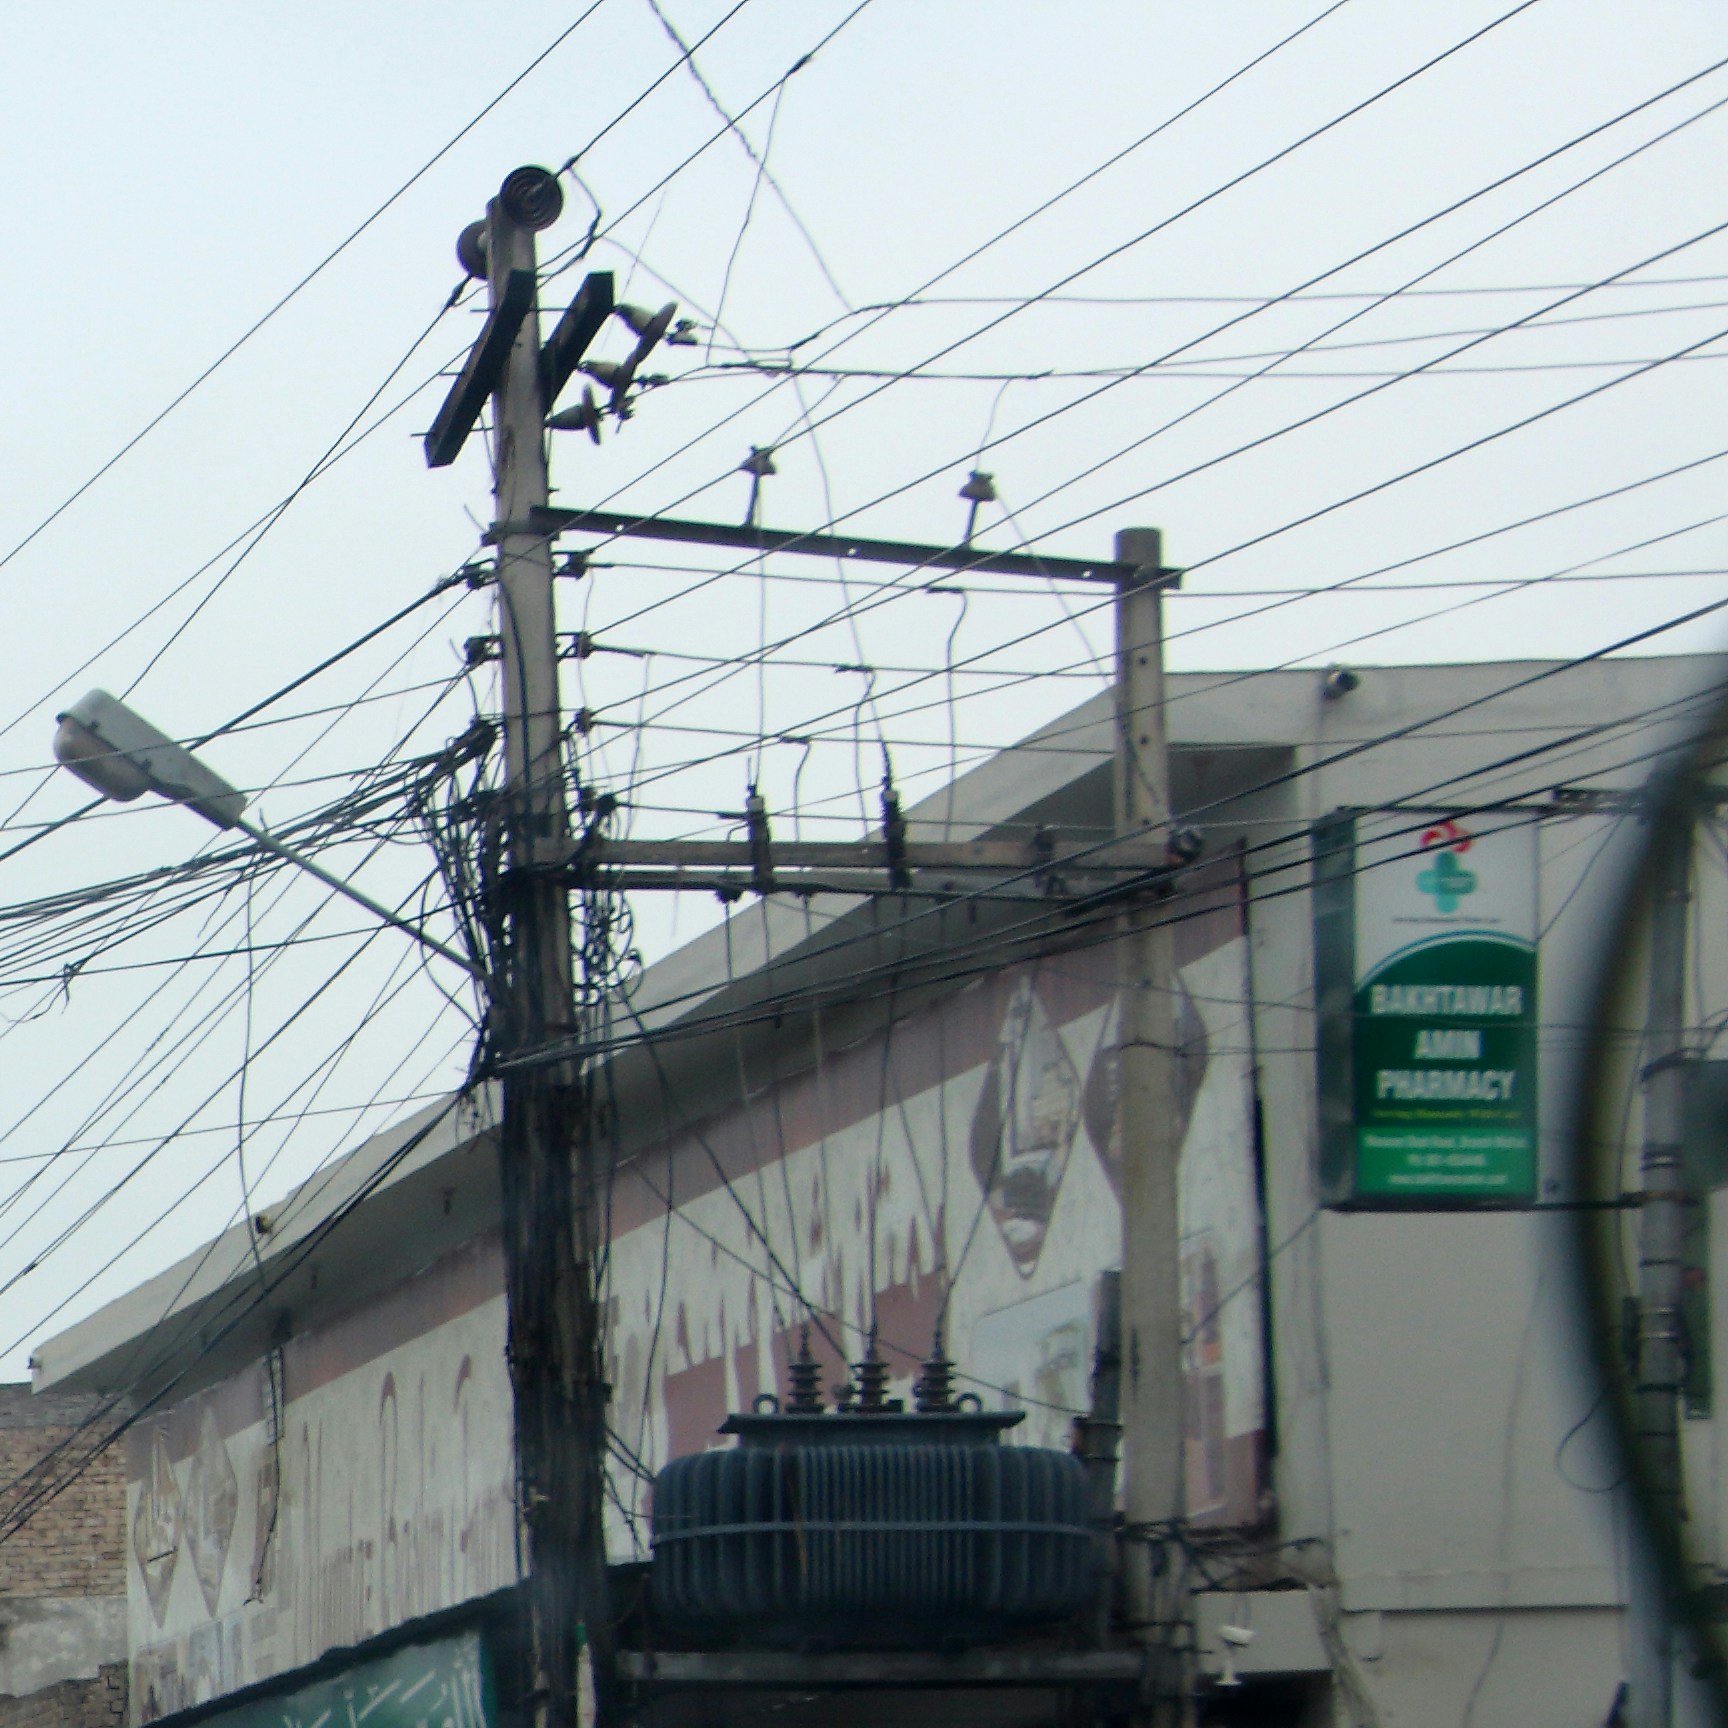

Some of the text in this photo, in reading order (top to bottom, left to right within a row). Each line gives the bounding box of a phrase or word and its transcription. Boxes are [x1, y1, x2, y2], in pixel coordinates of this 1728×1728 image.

[1370, 984, 1522, 1016] BAKHTAWAR
[1413, 1029, 1482, 1060] AMIN
[1376, 1069, 1516, 1100] PHARMACY
